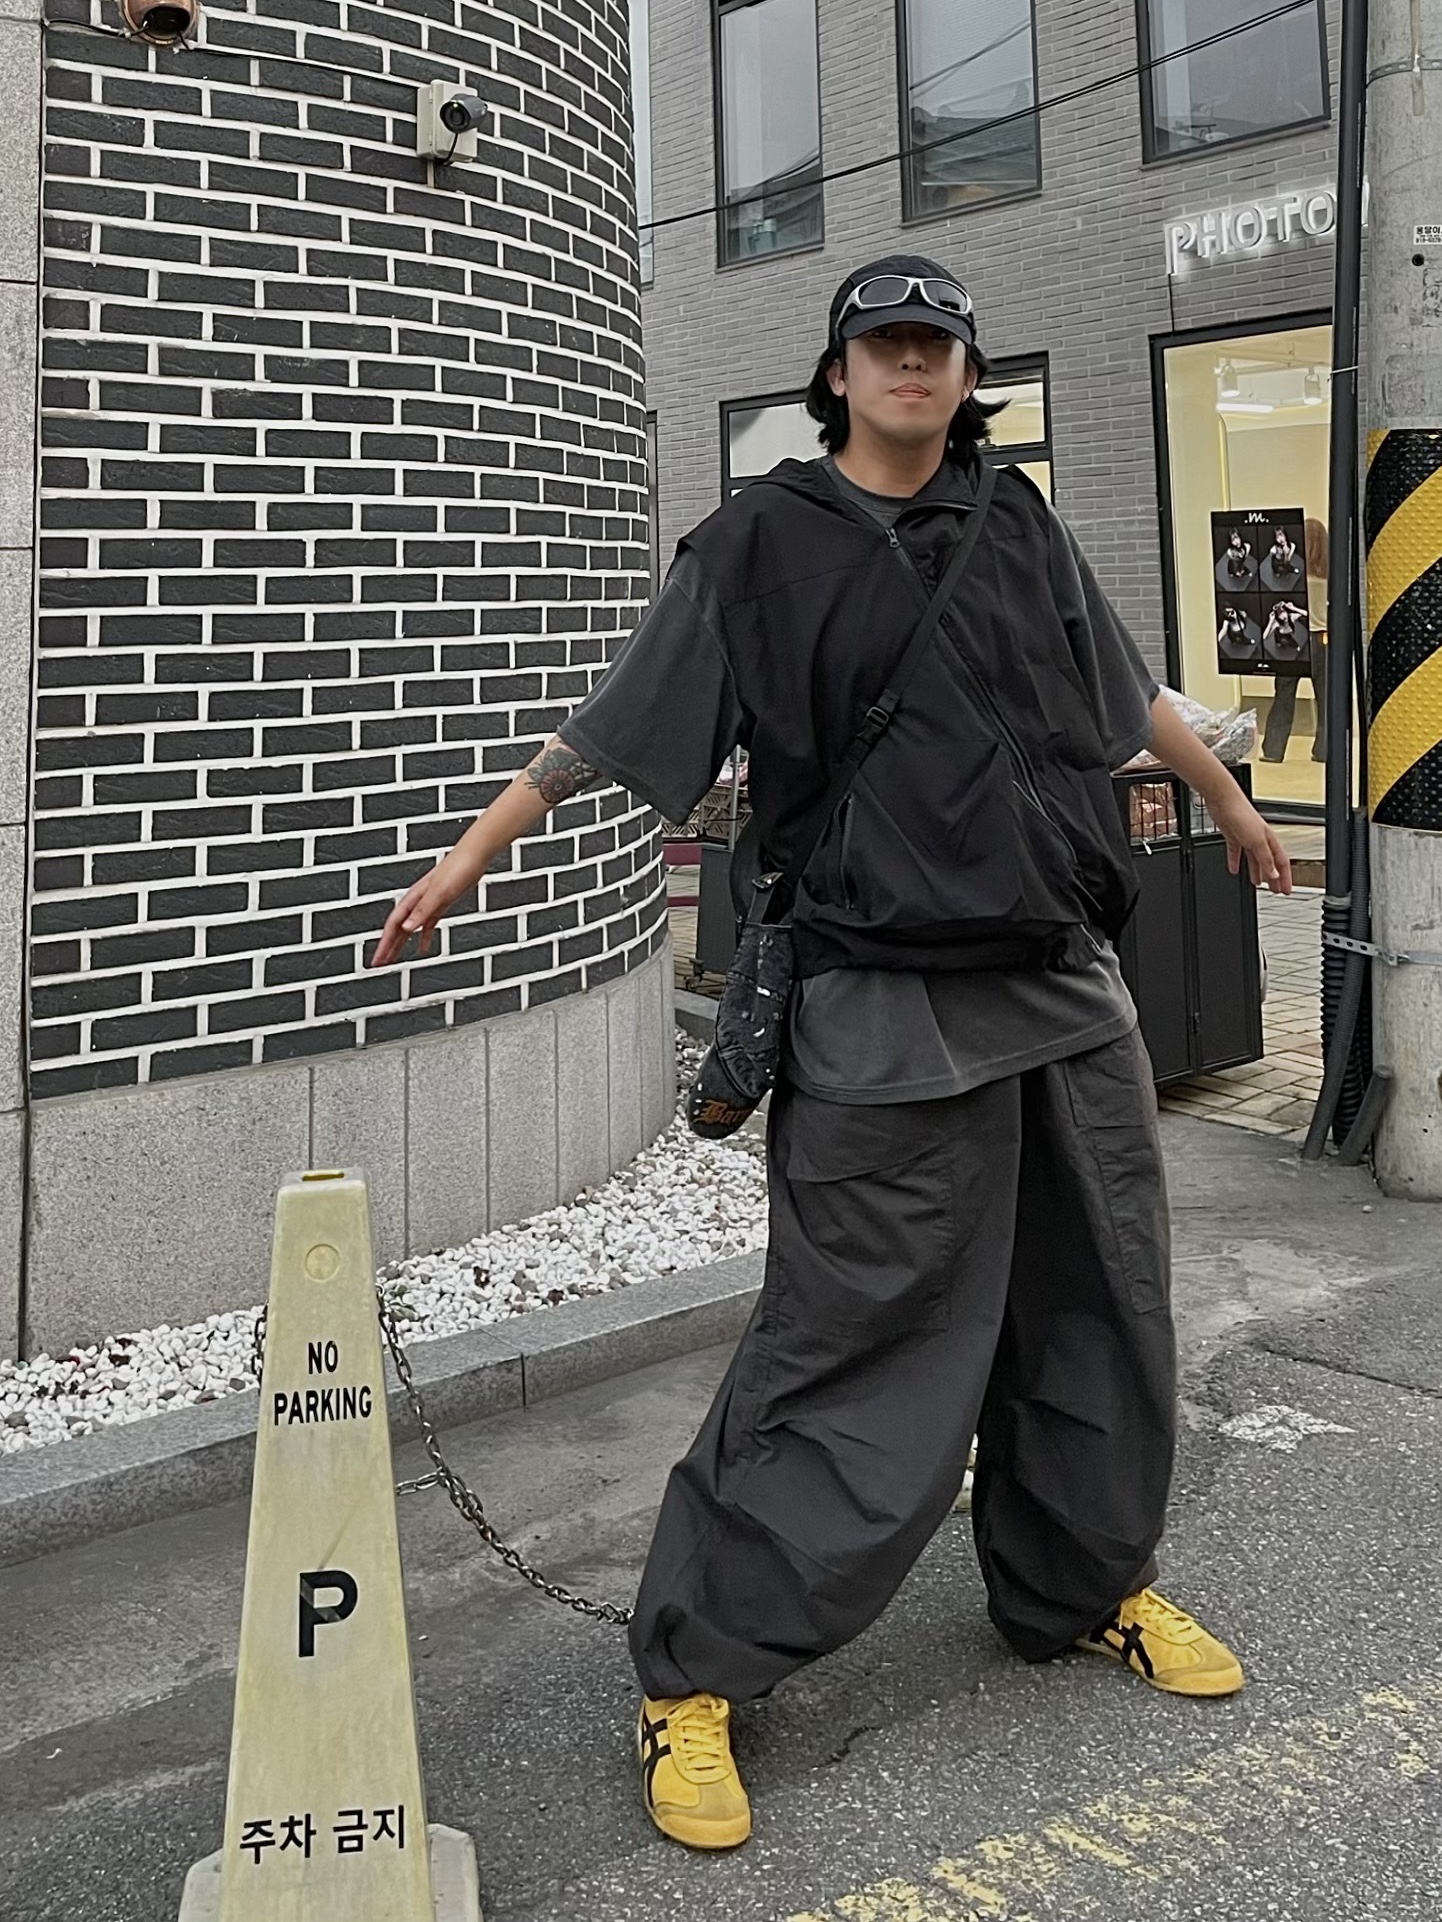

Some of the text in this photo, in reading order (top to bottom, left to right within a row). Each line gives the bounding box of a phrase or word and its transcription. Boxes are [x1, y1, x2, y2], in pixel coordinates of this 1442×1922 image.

[1164, 175, 1369, 276] PHOTO
[1416, 226, 1442, 235] 용달이
[308, 1340, 338, 1375] NO
[274, 1385, 372, 1426] PARKING
[299, 1570, 358, 1657] P
[240, 1804, 405, 1865] 주차 금지
